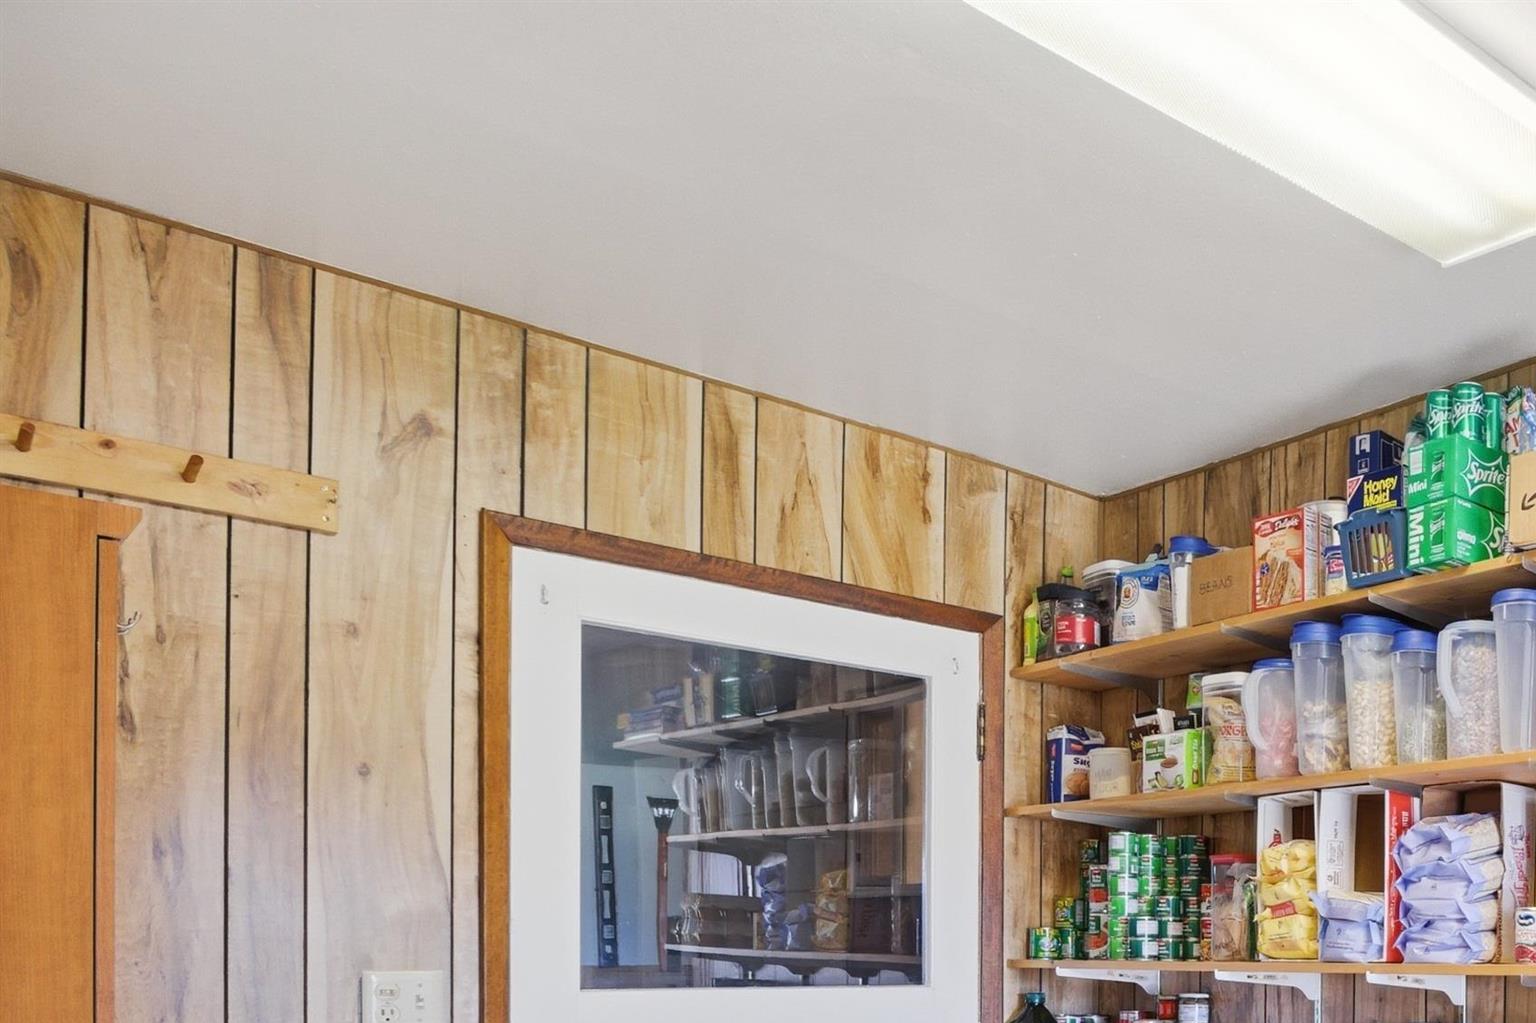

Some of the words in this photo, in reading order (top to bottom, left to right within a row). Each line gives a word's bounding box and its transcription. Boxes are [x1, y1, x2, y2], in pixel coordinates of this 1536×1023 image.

[1363, 475, 1398, 493] Honey
[1467, 461, 1506, 485] Sprite
[1408, 506, 1425, 566] Mini
